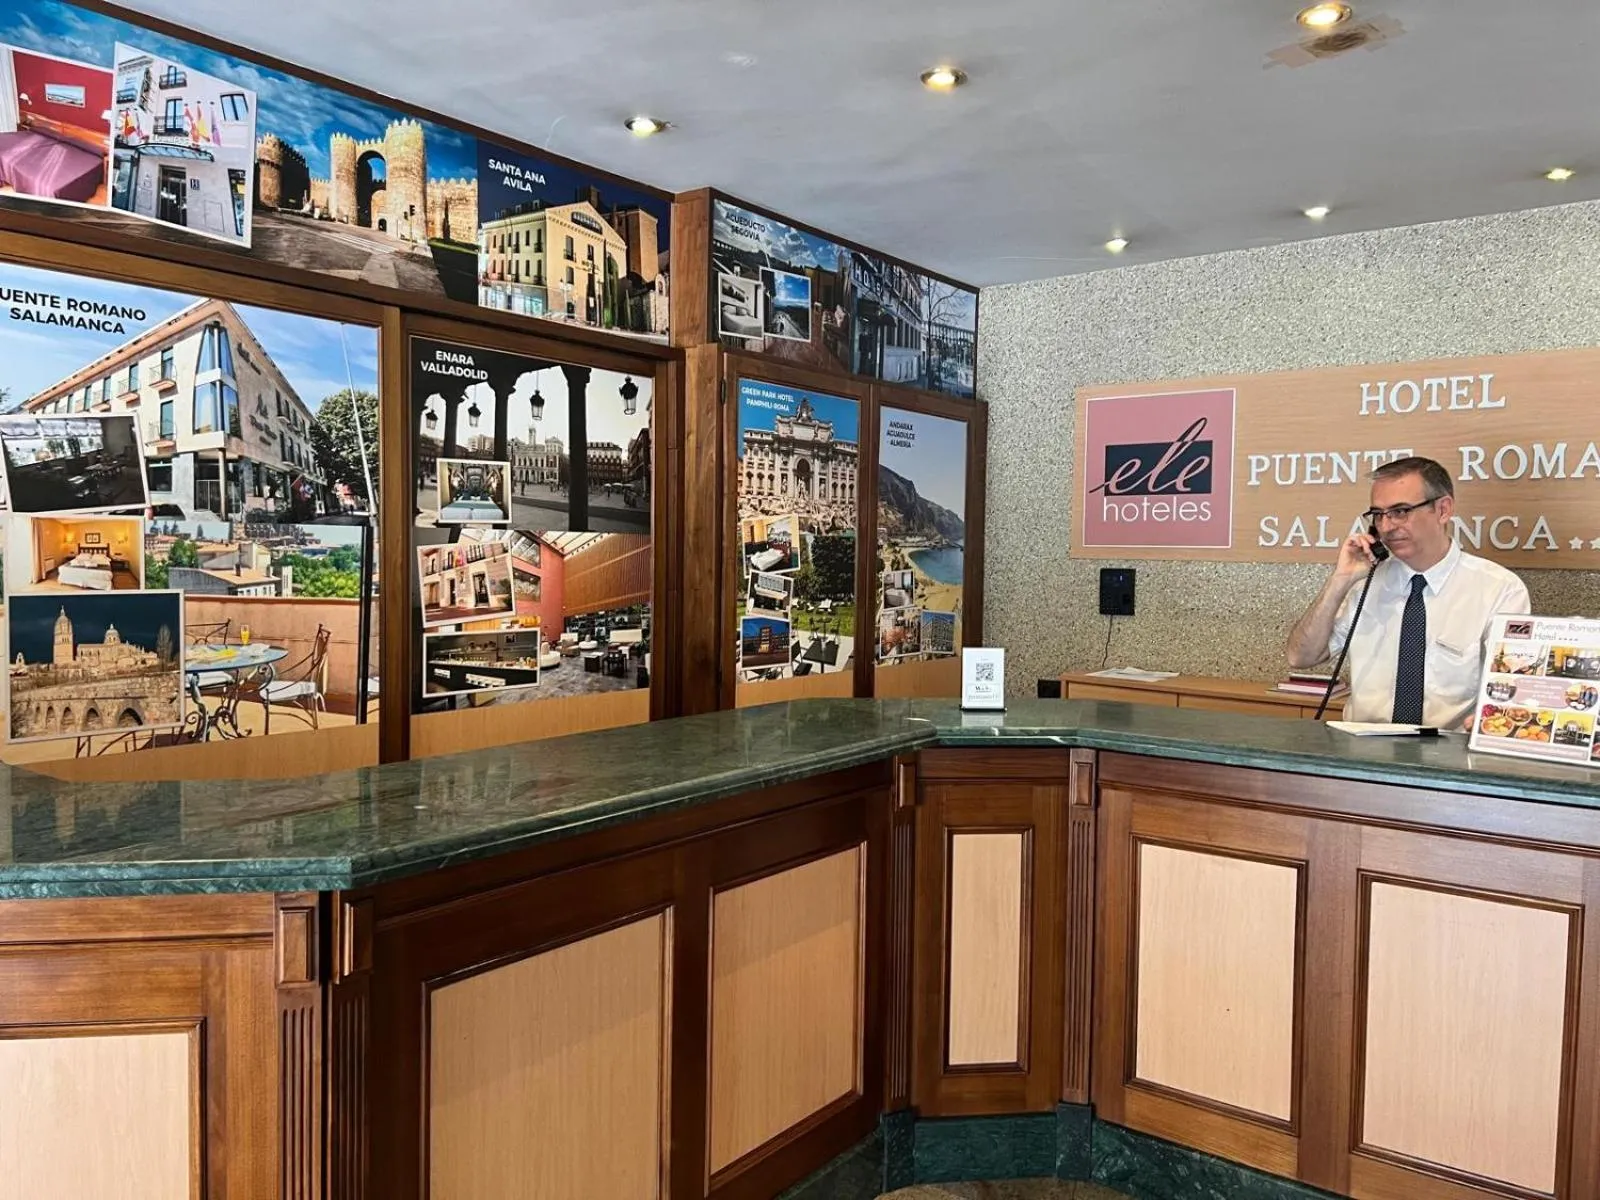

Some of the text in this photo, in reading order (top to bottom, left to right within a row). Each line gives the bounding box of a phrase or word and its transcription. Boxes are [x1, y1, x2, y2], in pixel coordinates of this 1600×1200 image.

[488, 159, 546, 185] SANTA ANA
[503, 176, 533, 193] AVILA
[726, 211, 766, 233] ACUEDUCTO
[10, 307, 126, 335] SALAMANCA
[66, 297, 146, 321] ROMANO
[420, 360, 489, 380] VALLADOLID
[435, 350, 475, 366] ENARA
[741, 387, 795, 403] GREEN PARK HOTEL
[1358, 374, 1506, 416] HOTEL
[1088, 417, 1211, 495] ele
[1102, 497, 1212, 522] hoteles
[1258, 514, 1560, 552] SALANCA
